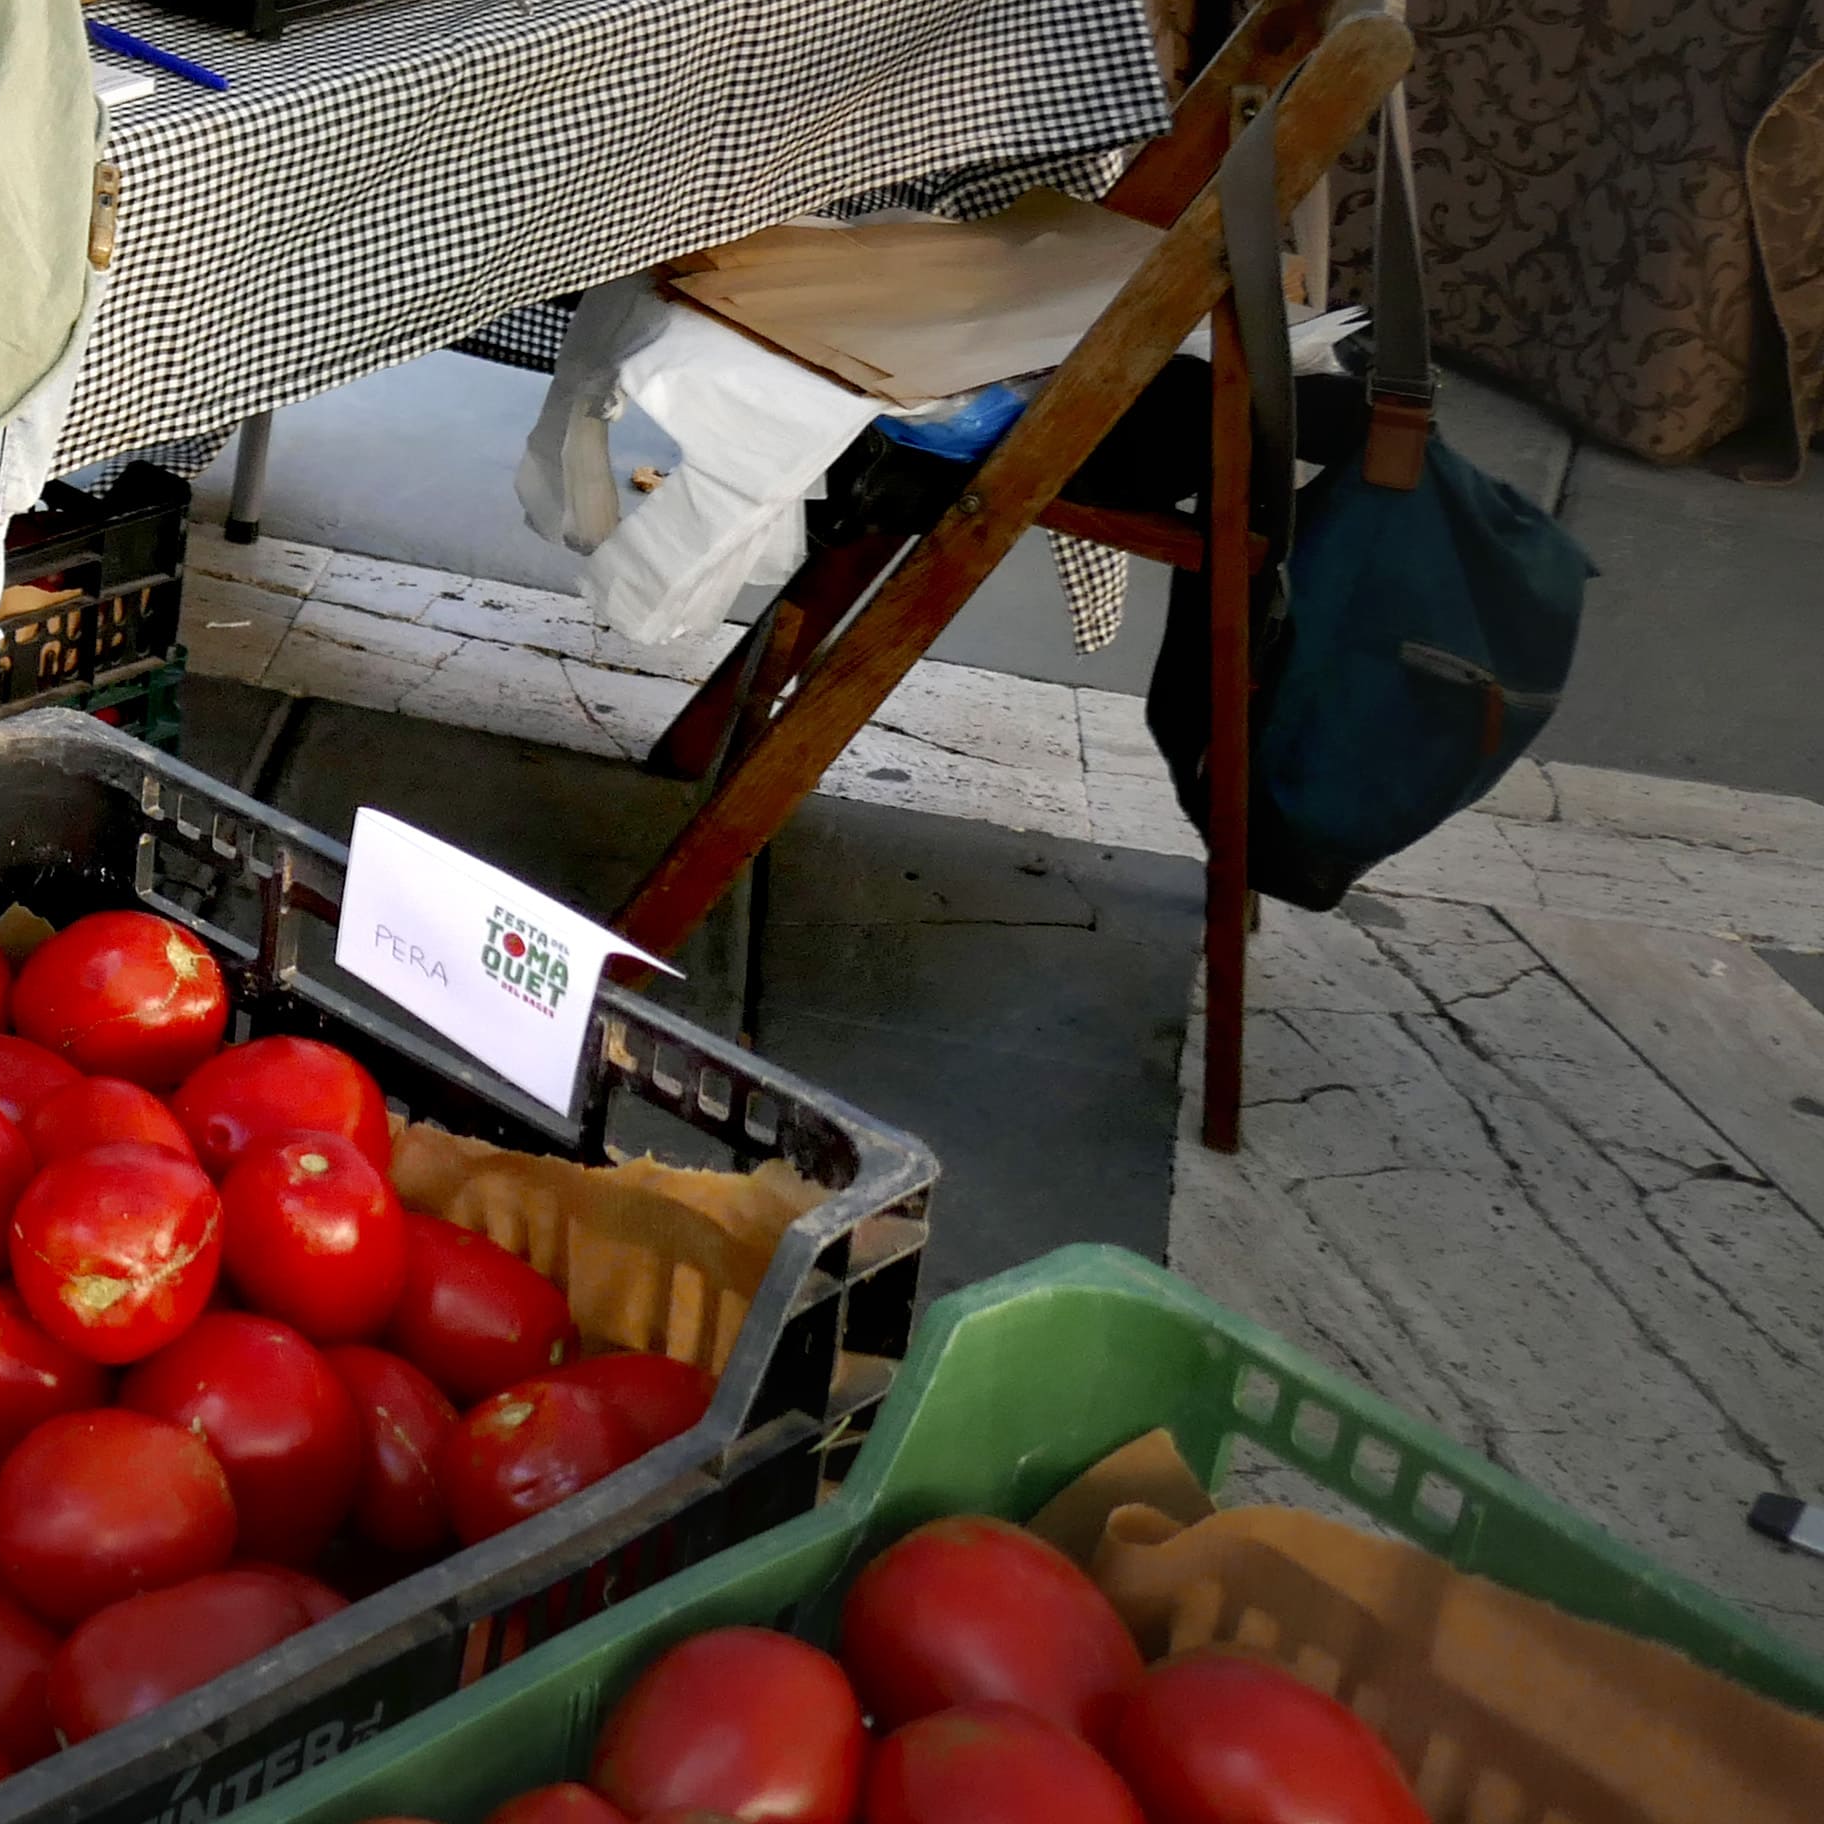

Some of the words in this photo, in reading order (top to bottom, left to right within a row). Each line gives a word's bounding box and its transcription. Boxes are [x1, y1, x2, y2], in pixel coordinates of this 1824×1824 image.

[374, 924, 449, 987] PERA
[493, 904, 549, 948] FESTA
[551, 938, 570, 957] DEL
[481, 943, 566, 1008] QUET
